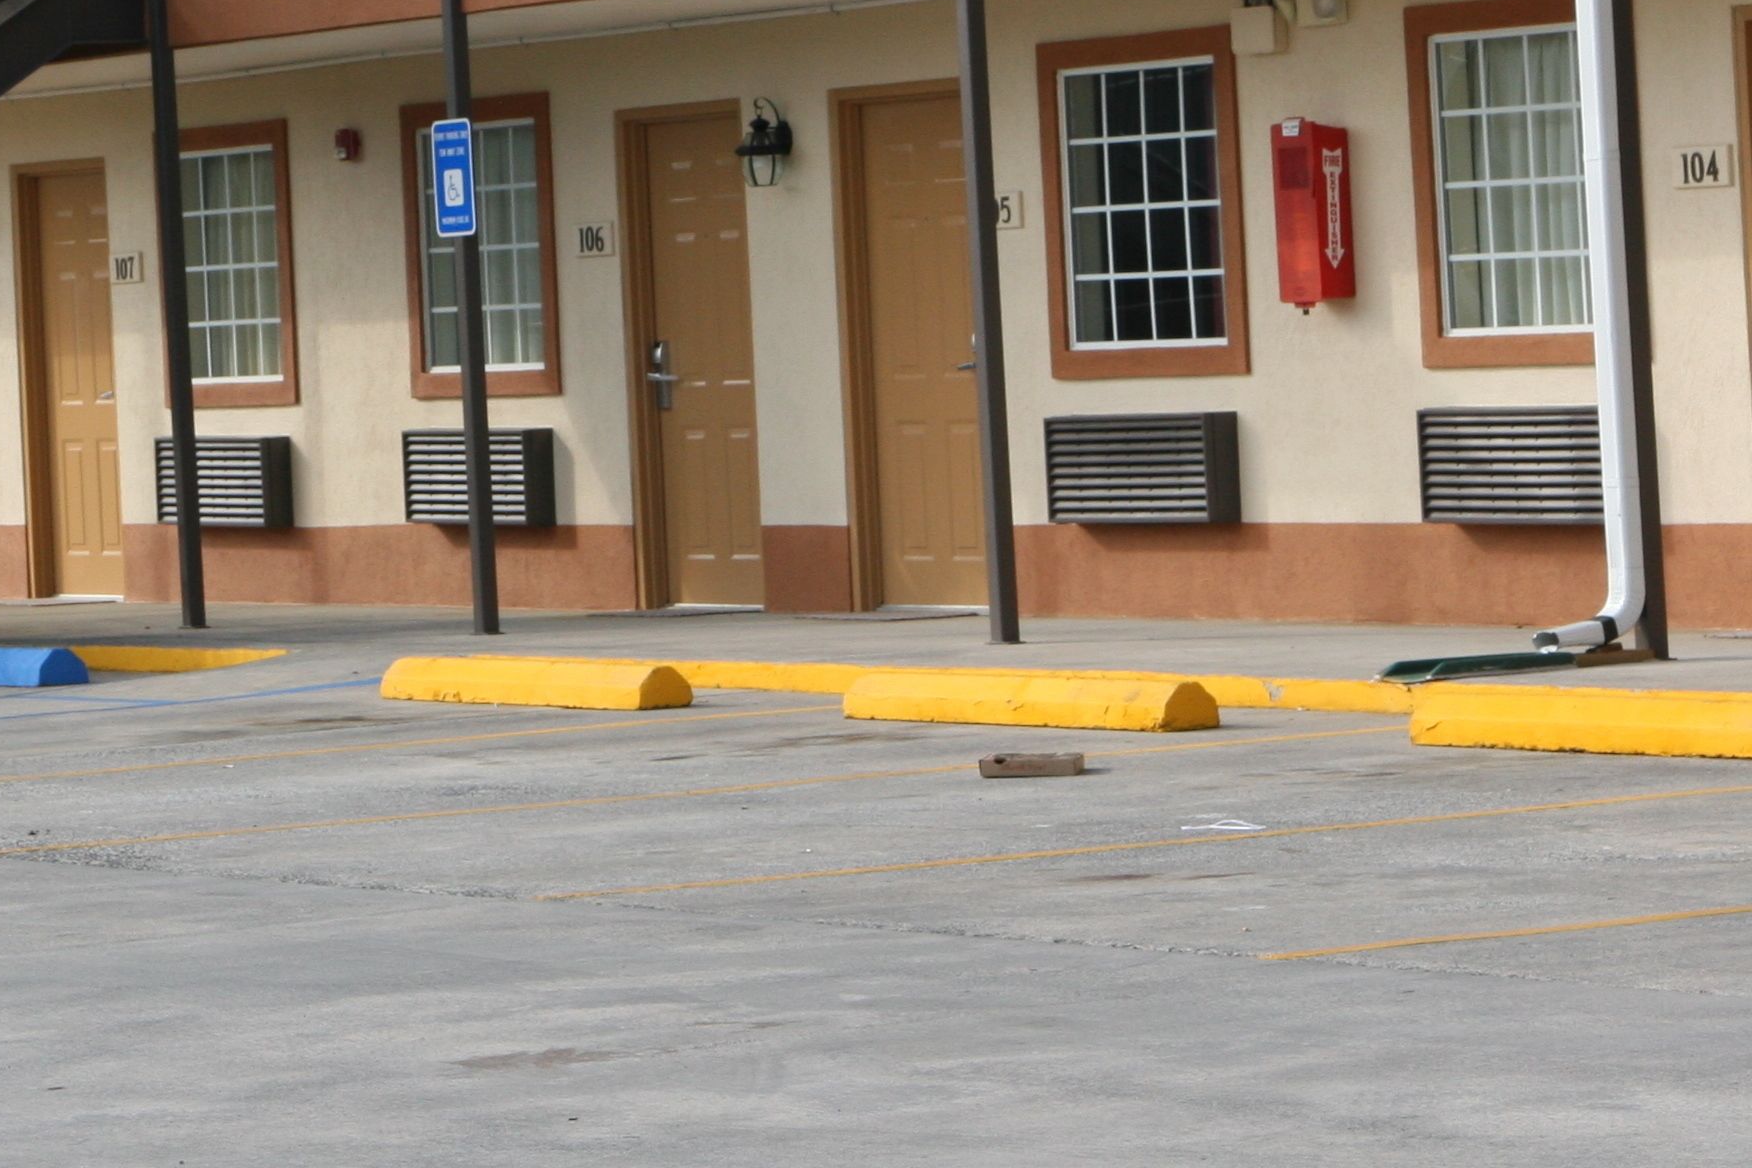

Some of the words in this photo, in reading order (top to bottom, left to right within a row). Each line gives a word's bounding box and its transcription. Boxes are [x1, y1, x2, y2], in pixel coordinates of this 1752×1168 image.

[1324, 155, 1341, 167] FIRE
[1681, 149, 1720, 184] 104
[1329, 172, 1338, 261] EXTINGUISHER
[578, 226, 604, 253] 106
[114, 256, 135, 280] 107
